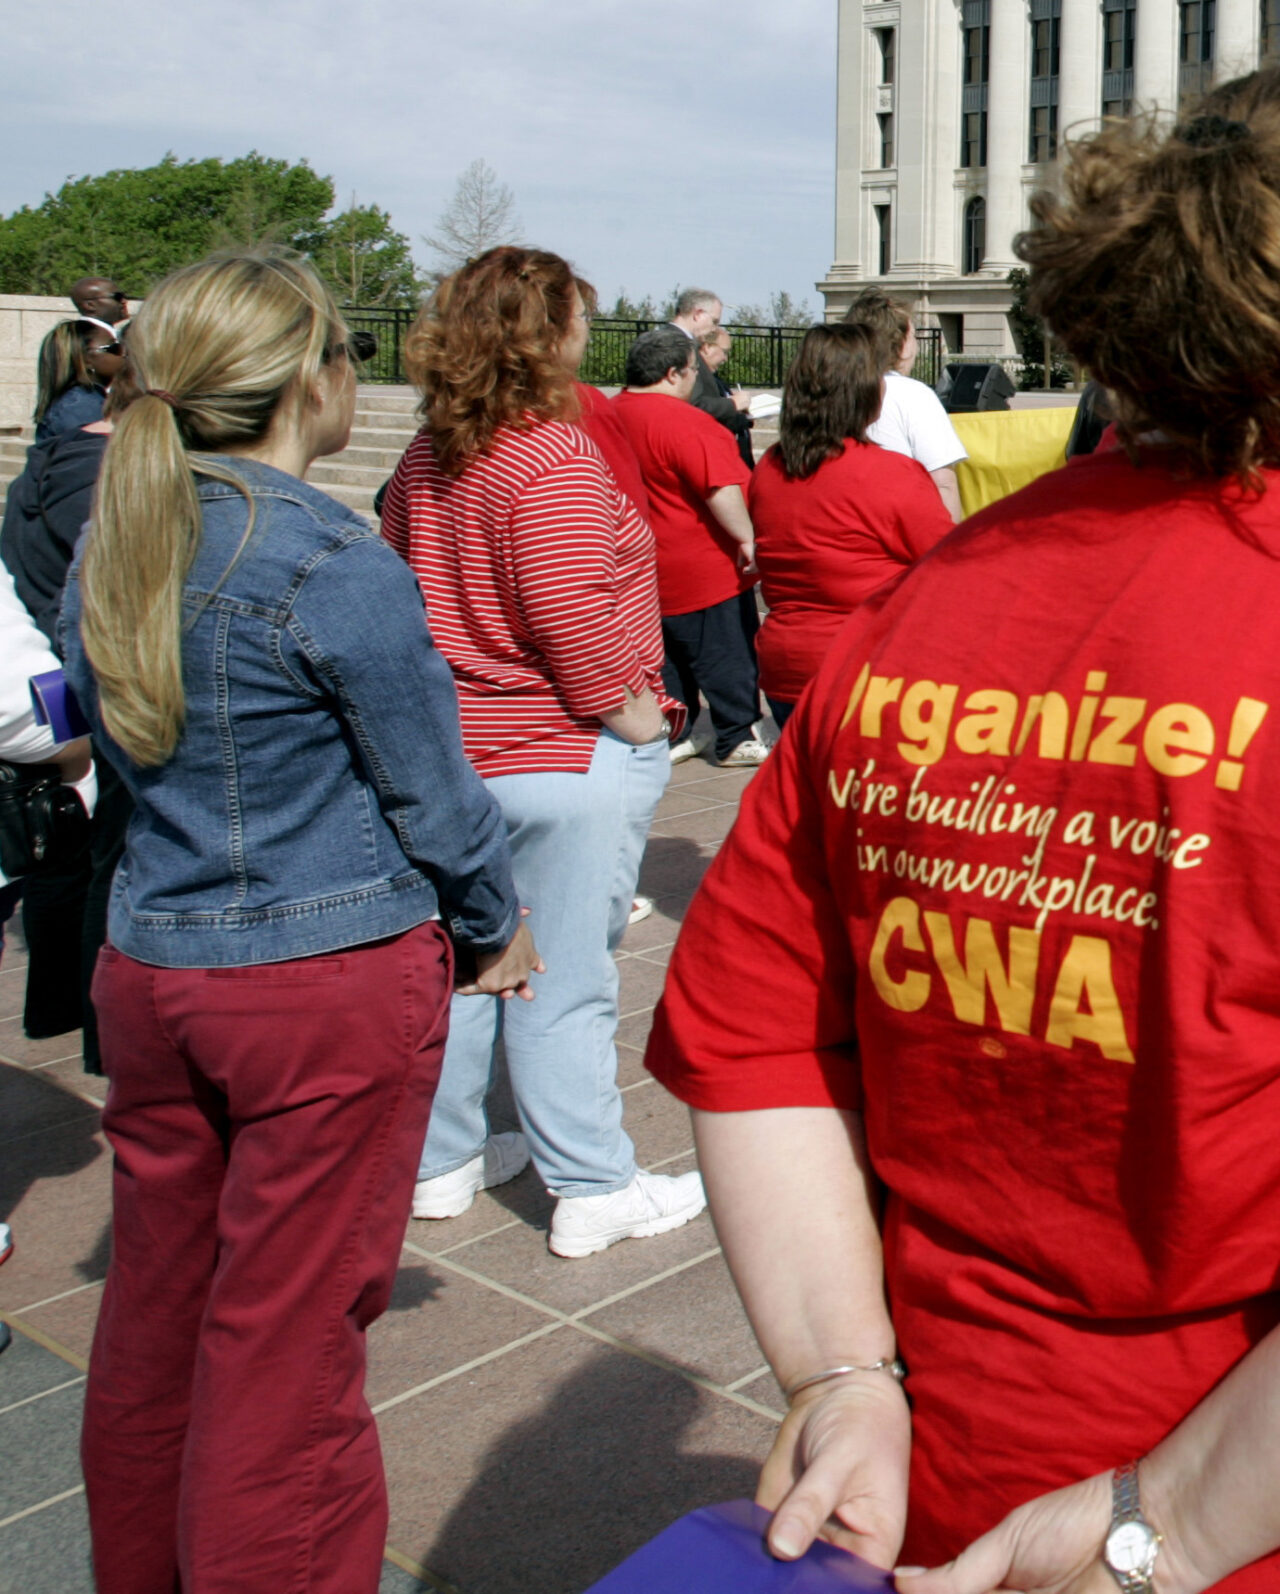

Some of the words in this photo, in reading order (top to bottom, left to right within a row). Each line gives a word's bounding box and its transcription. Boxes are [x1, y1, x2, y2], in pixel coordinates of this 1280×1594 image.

[839, 661, 1269, 792] rganize!
[856, 827, 889, 874] in
[1063, 811, 1094, 846] a
[1110, 806, 1211, 870] voice
[868, 896, 1136, 1065] CWA
